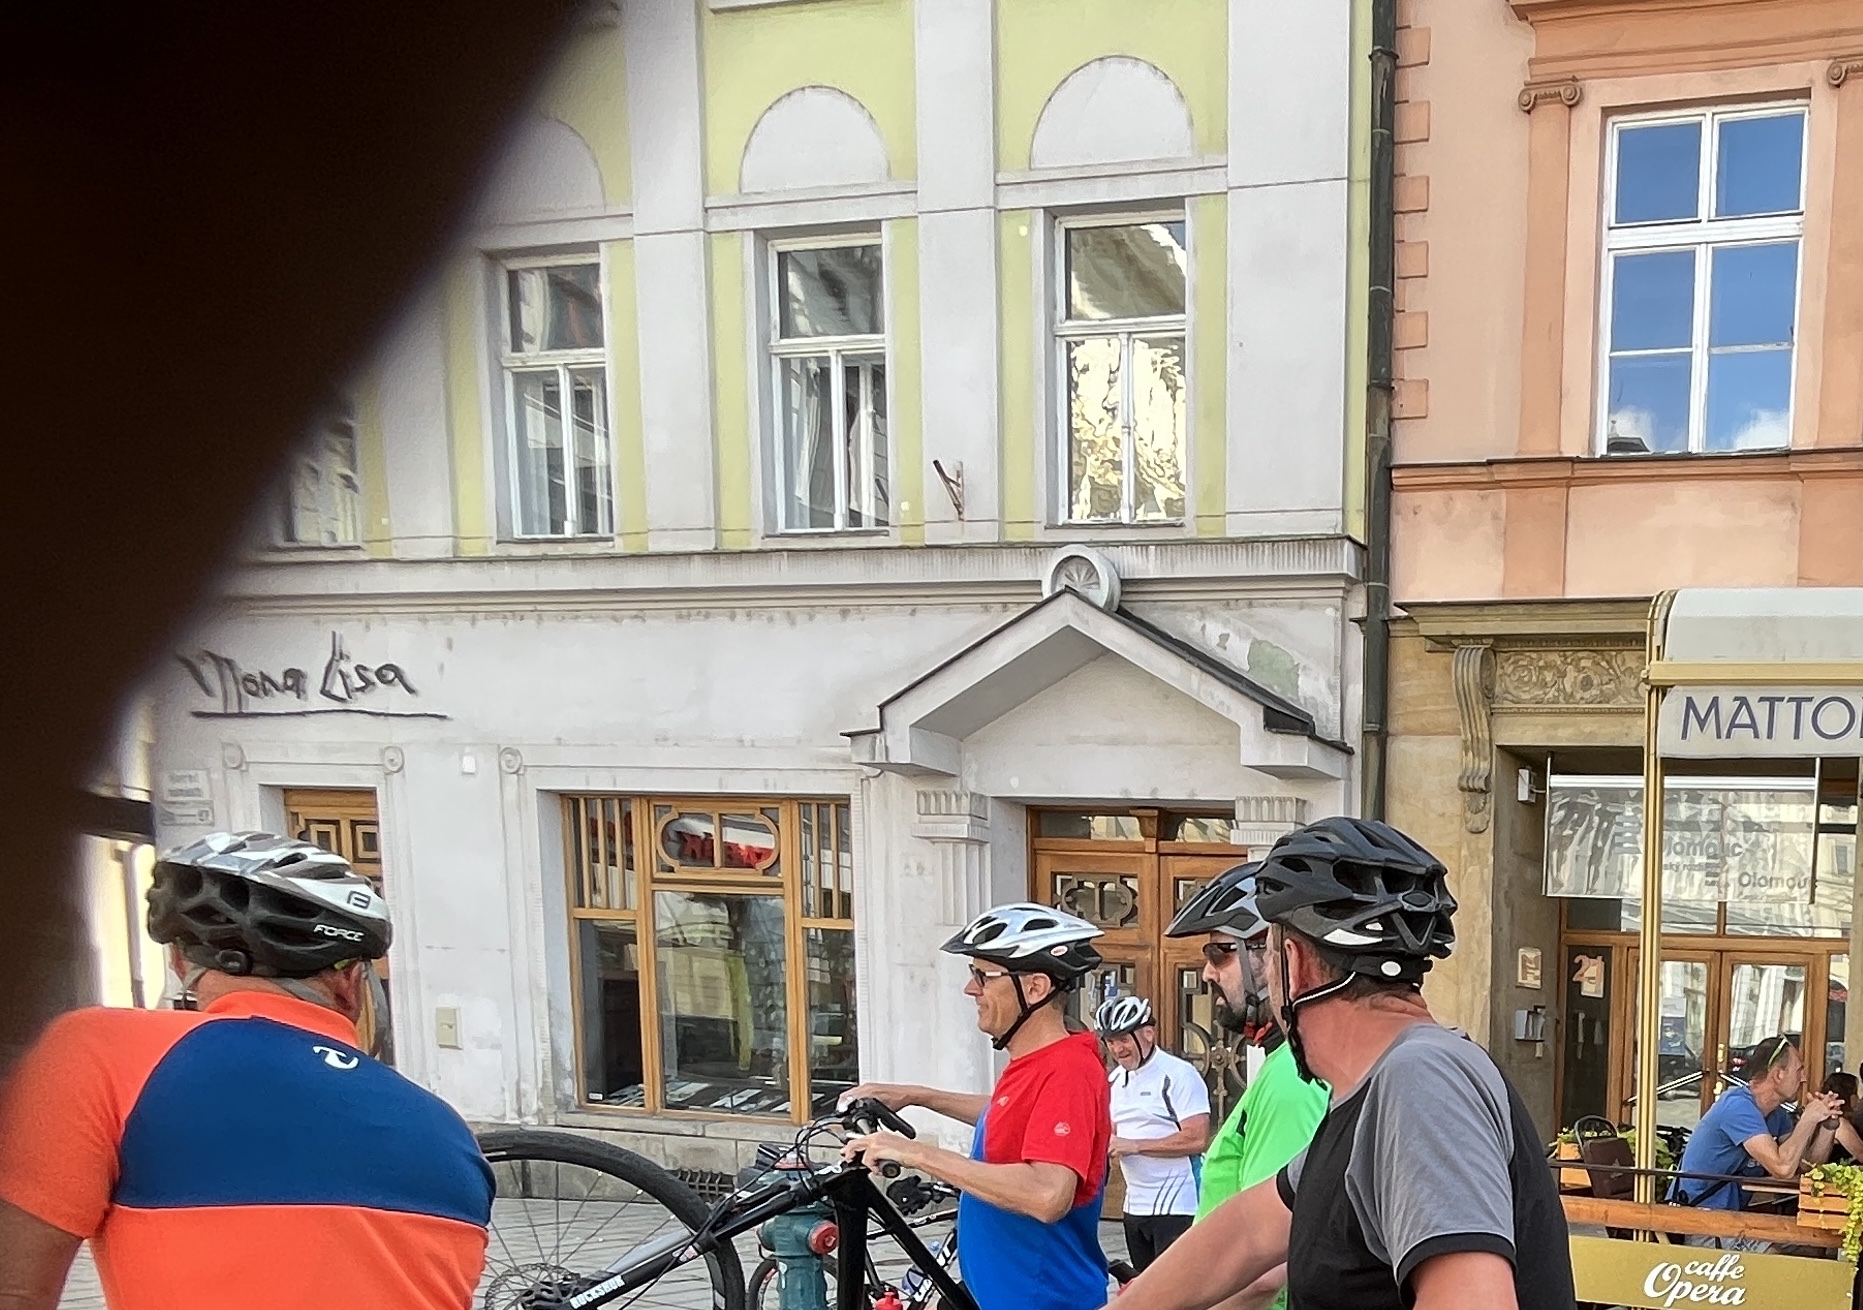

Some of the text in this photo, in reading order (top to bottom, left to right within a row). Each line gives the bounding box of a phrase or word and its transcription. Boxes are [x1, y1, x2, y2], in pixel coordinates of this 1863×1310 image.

[319, 631, 417, 703] Lisa
[1738, 870, 1808, 890] Olomou
[313, 923, 365, 942] FORCE
[1684, 1253, 1746, 1282] caffe
[1643, 1262, 1746, 1308] Opera
